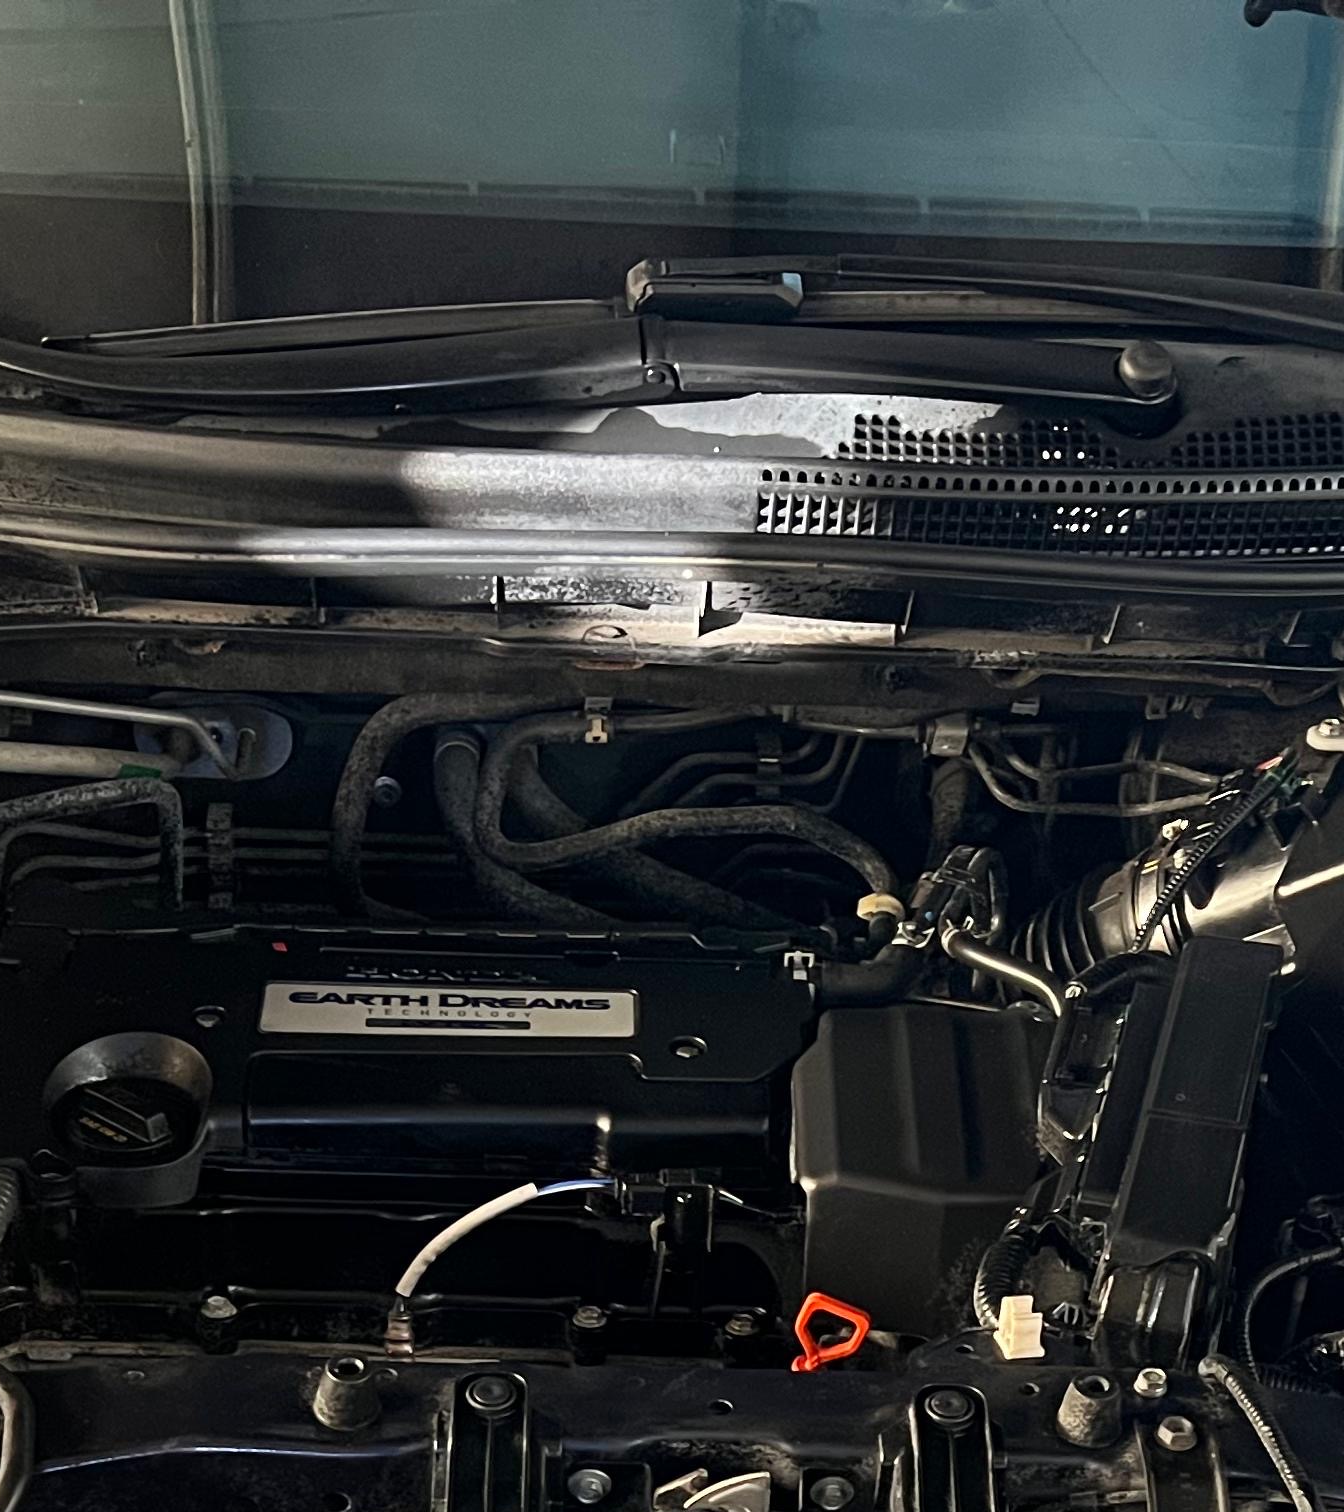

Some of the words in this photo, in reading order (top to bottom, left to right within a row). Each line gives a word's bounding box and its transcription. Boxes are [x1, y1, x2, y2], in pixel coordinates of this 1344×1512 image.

[288, 991, 429, 1007] EARTH
[438, 993, 611, 1011] DREAMS
[367, 1008, 533, 1018] TECHNOLOGY
